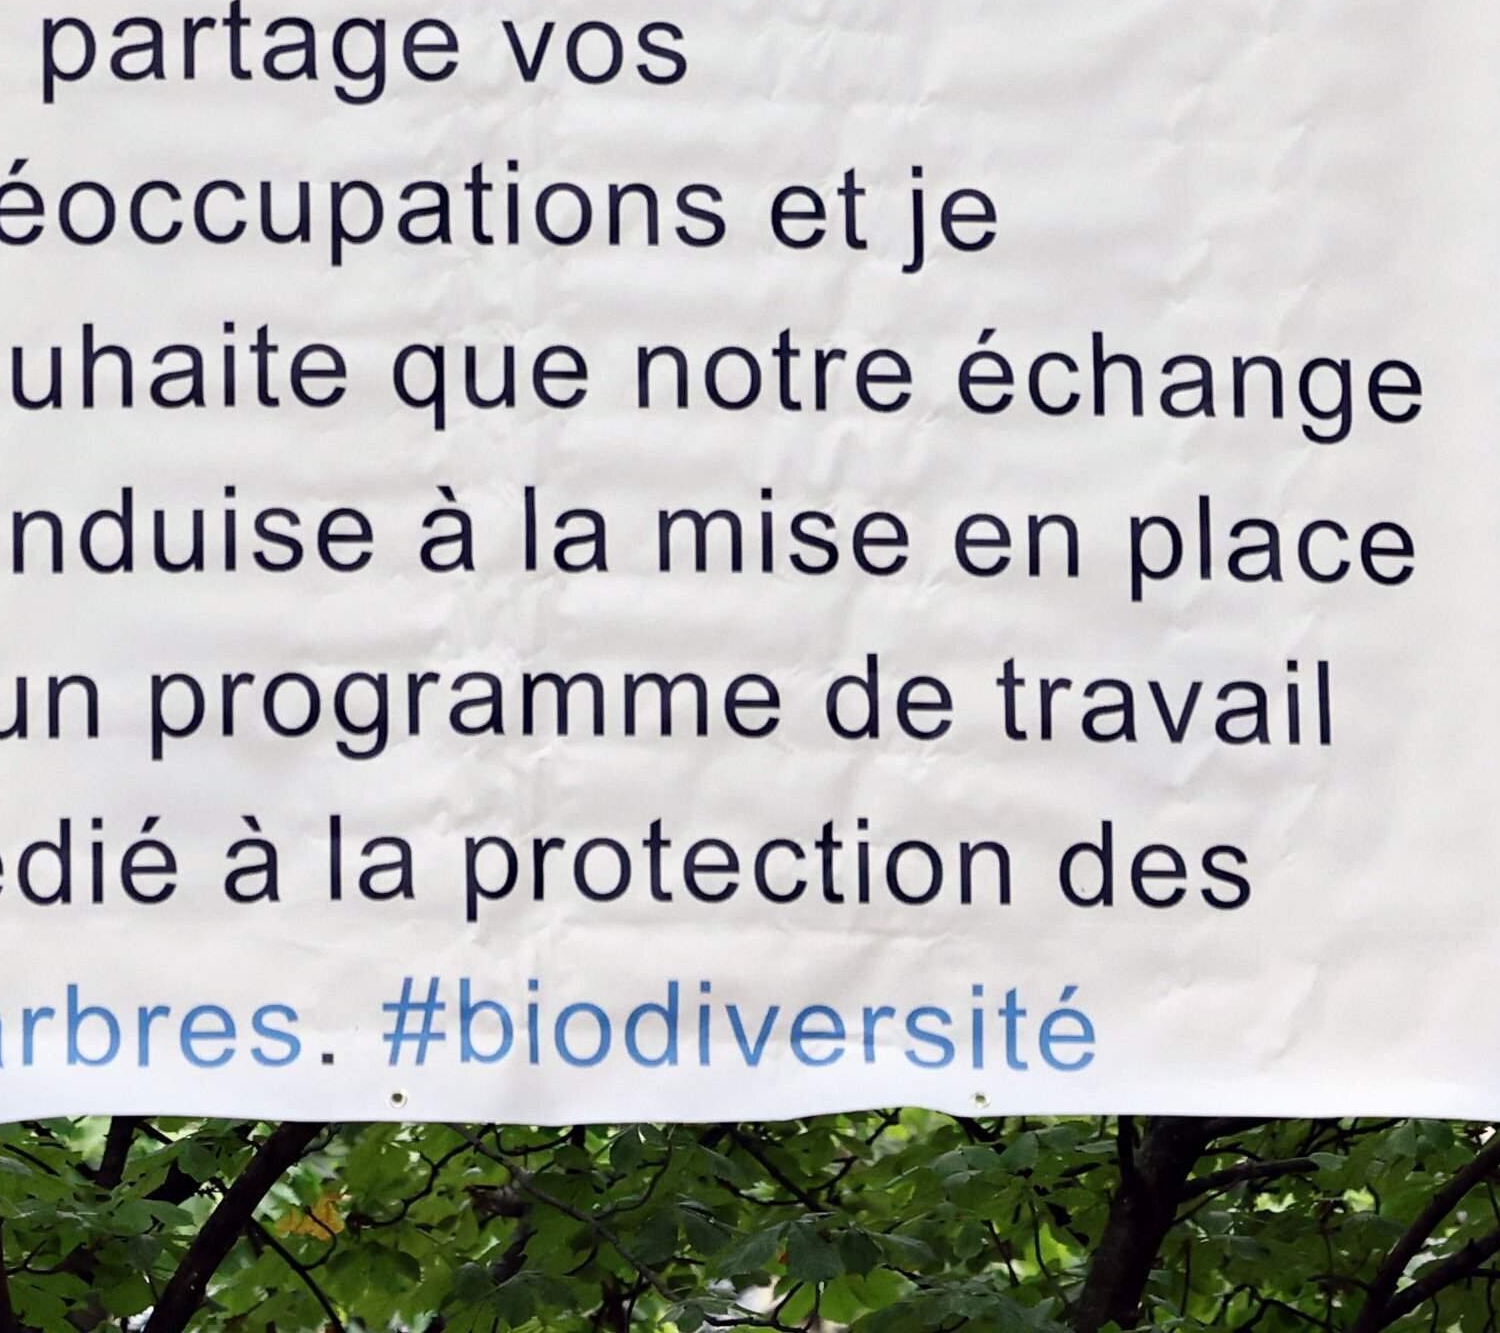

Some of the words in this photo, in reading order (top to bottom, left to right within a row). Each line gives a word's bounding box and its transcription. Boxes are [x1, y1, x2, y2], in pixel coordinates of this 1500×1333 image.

[500, 19, 689, 87] vos
[769, 166, 870, 252] et
[900, 163, 999, 276] je
[391, 342, 590, 433] que
[636, 326, 914, 415] notre
[956, 326, 1424, 447] échange
[418, 483, 477, 575] à
[522, 483, 610, 575] la
[657, 485, 911, 578] mise
[953, 511, 1081, 580] en
[1128, 493, 1416, 604] place
[149, 669, 782, 763] programme
[824, 651, 955, 743] de
[994, 656, 1333, 748] travail
[222, 813, 282, 906] à
[328, 812, 417, 903] la
[463, 816, 1013, 925] protection
[1057, 818, 1252, 912] des
[380, 975, 1097, 1073] #biodiversité
